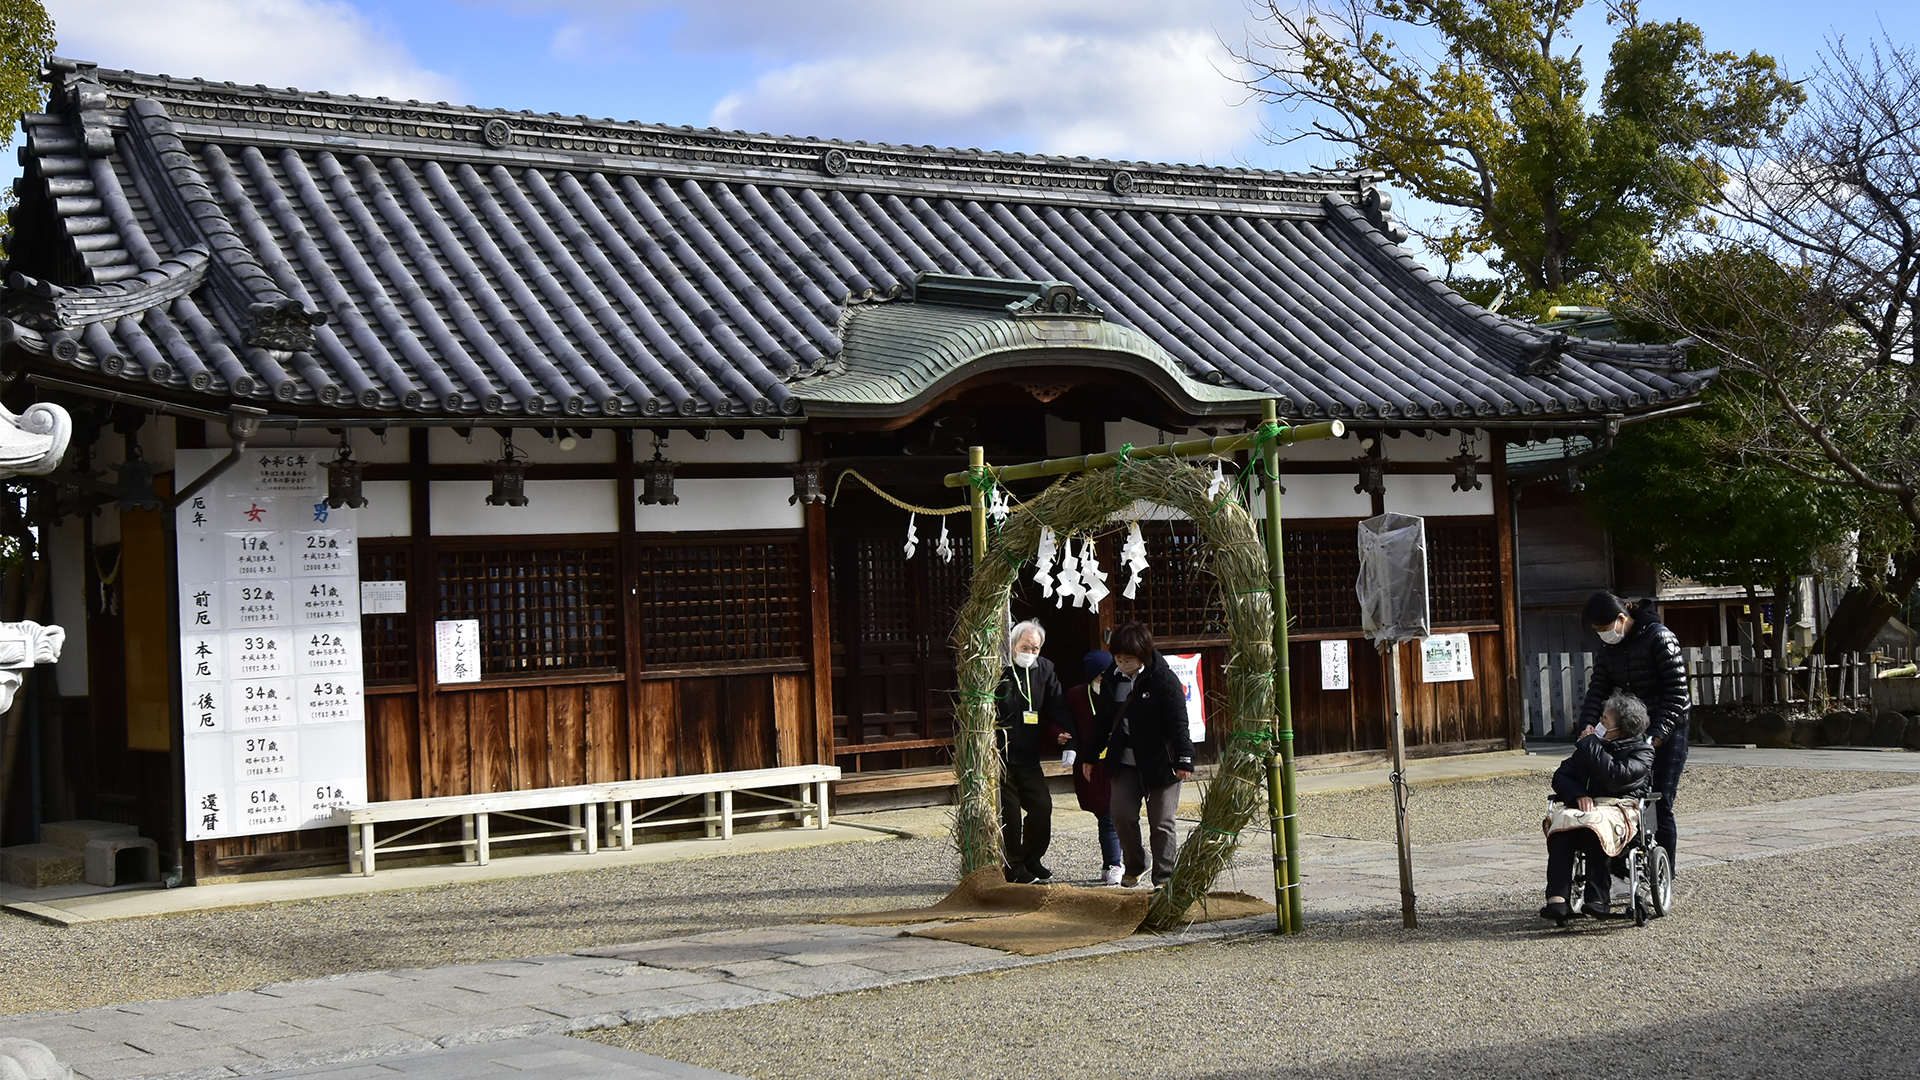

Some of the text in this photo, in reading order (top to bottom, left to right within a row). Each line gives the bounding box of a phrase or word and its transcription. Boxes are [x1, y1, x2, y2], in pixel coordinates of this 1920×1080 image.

[258, 455, 308, 468] 令和6年
[192, 496, 207, 527] 厄年
[244, 503, 266, 522] 女
[313, 503, 329, 524] 男
[241, 538, 269, 551] 19歳
[307, 536, 338, 550] 25歳
[242, 587, 275, 601] 32歳
[310, 584, 339, 597] 41歳
[193, 590, 212, 625] 前厄
[244, 637, 277, 650] 33歳
[310, 634, 343, 647] 42歳
[454, 623, 468, 678] とんど祭
[195, 641, 213, 676] 本厄
[1333, 642, 1341, 687] とんど祭
[245, 686, 277, 700] 34歳
[313, 682, 345, 696] 43歳
[197, 692, 217, 728] 後厄
[246, 738, 278, 752] 37歳
[251, 790, 279, 804] 61歳
[316, 786, 344, 799] 61歳
[200, 793, 220, 831] 還暦
